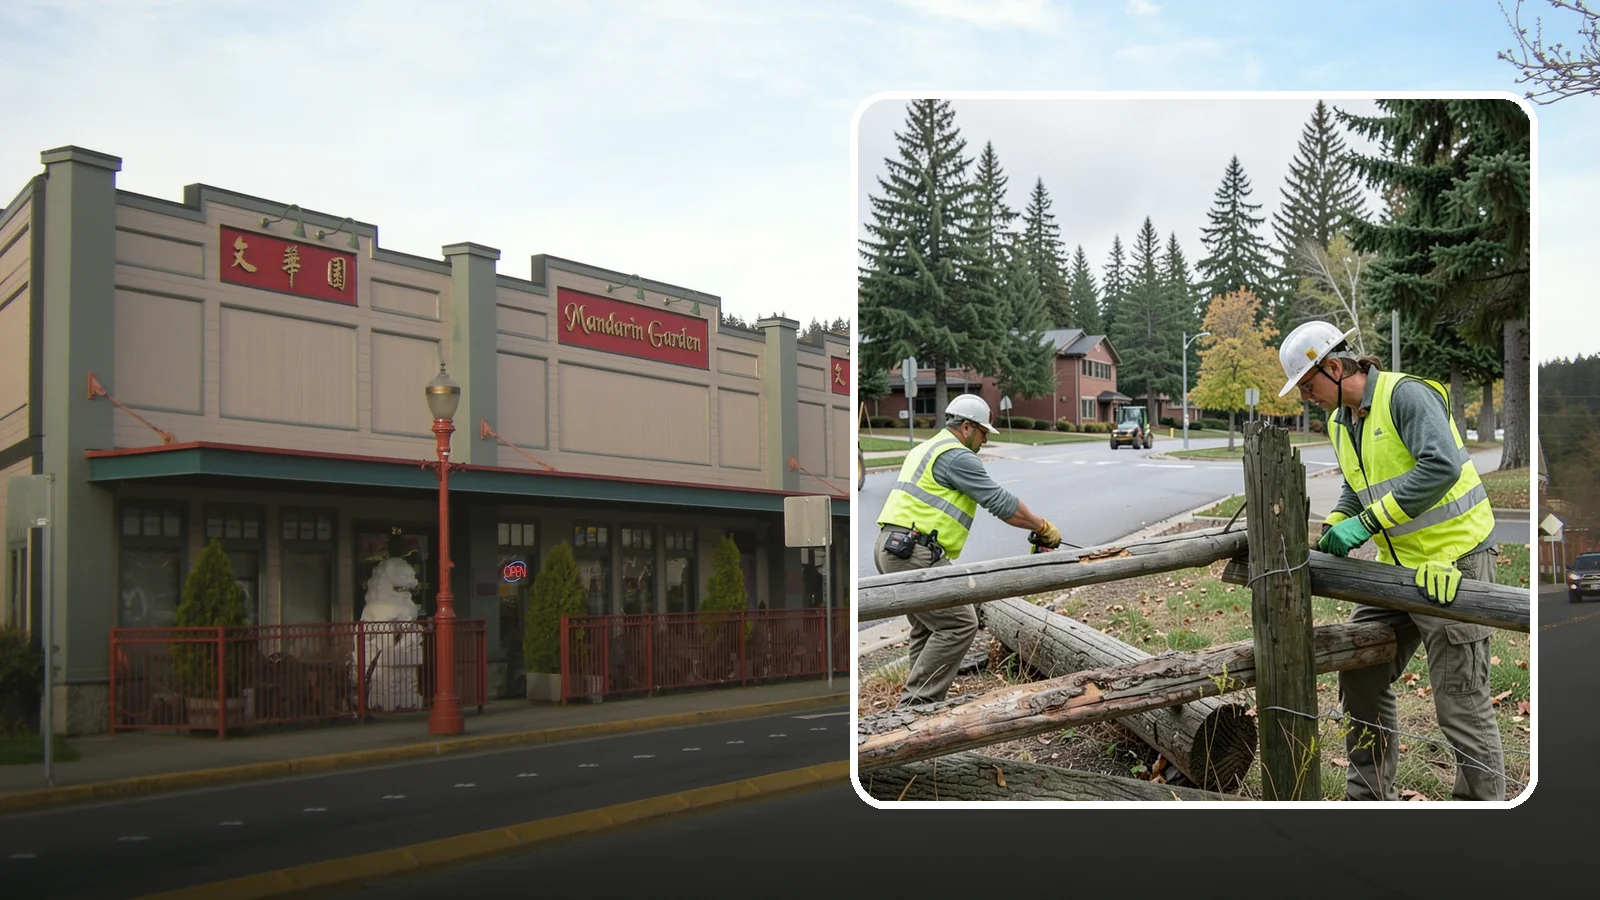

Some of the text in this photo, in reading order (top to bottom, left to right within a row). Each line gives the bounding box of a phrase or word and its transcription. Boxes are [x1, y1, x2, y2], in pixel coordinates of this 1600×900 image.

[230, 235, 346, 291] 文華園
[564, 302, 701, 352] Mandarin Garden
[503, 565, 527, 578] OPEN
